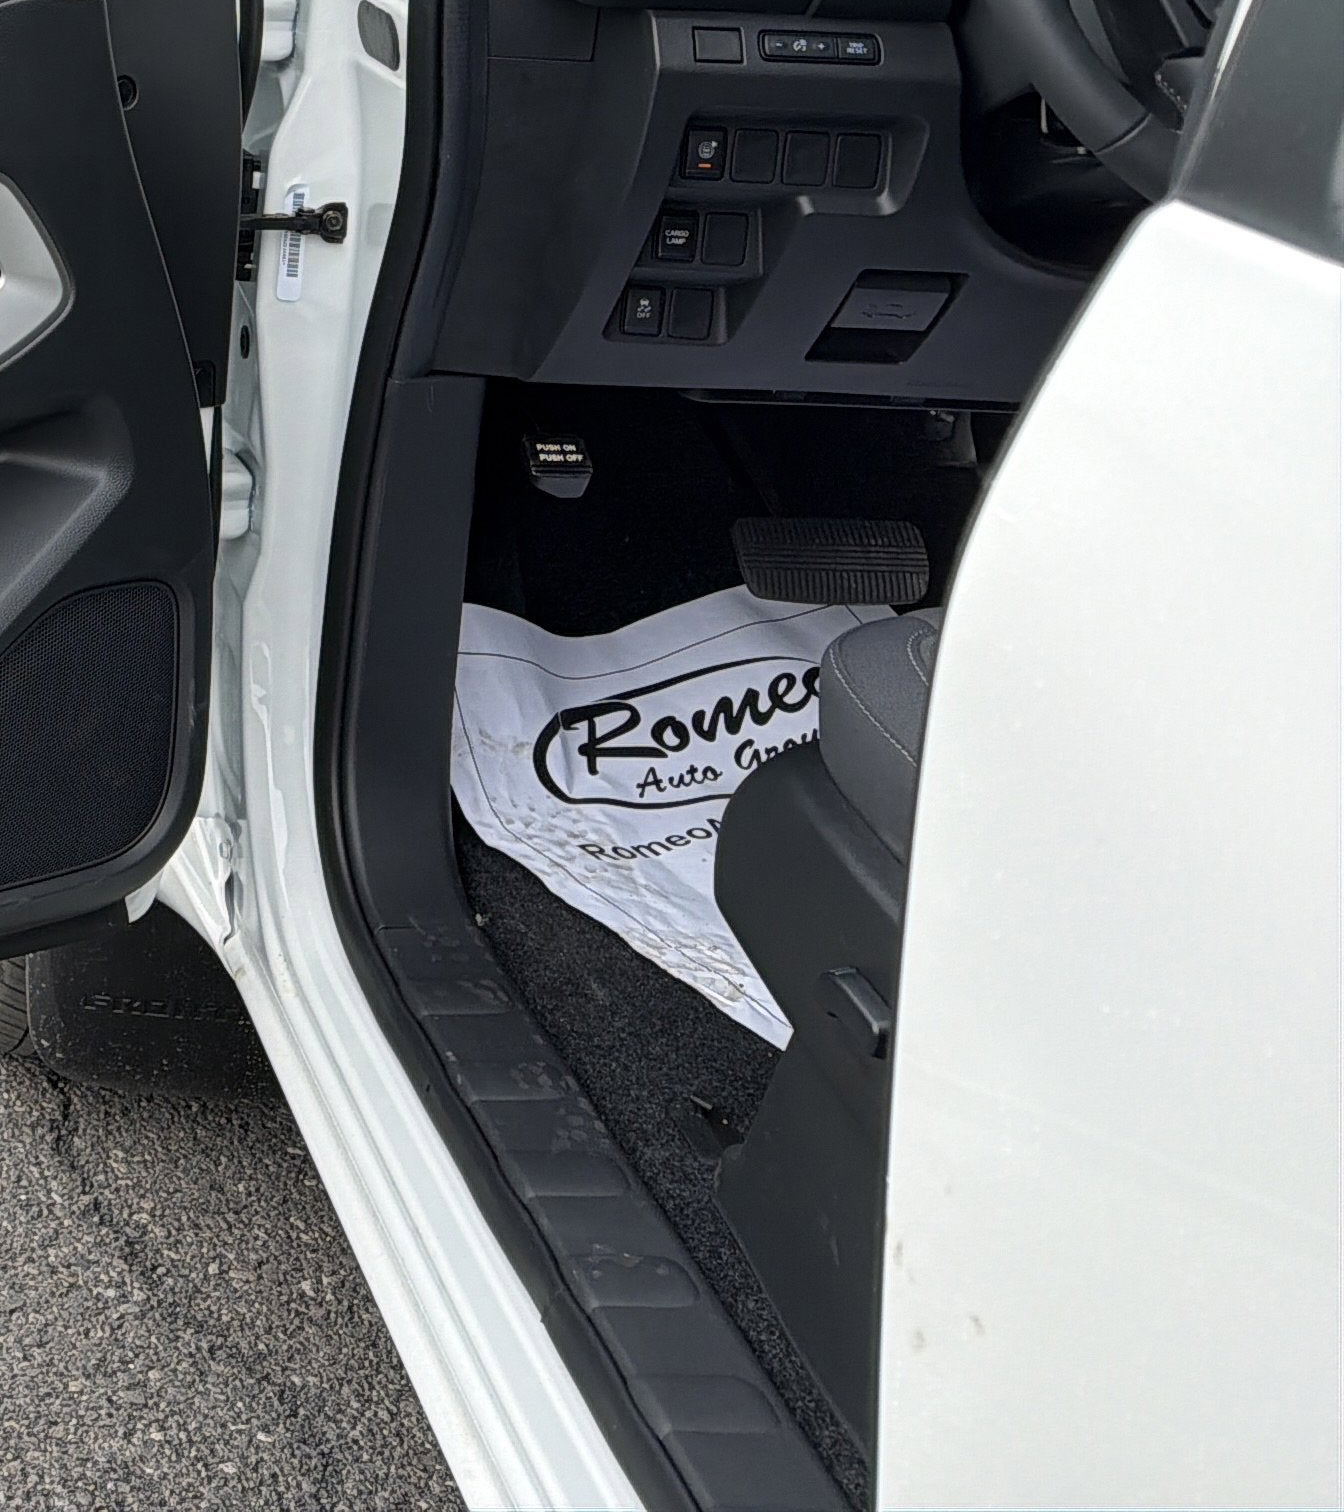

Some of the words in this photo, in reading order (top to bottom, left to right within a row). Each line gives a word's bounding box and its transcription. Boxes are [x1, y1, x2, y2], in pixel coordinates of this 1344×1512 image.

[665, 229, 690, 238] CARGO
[636, 311, 651, 319] OFF
[536, 443, 562, 451] PUSH
[562, 444, 577, 452] ON
[539, 453, 565, 462] PUSH
[565, 454, 584, 462] OFF
[635, 763, 723, 799] Auto
[733, 727, 821, 771] Grou
